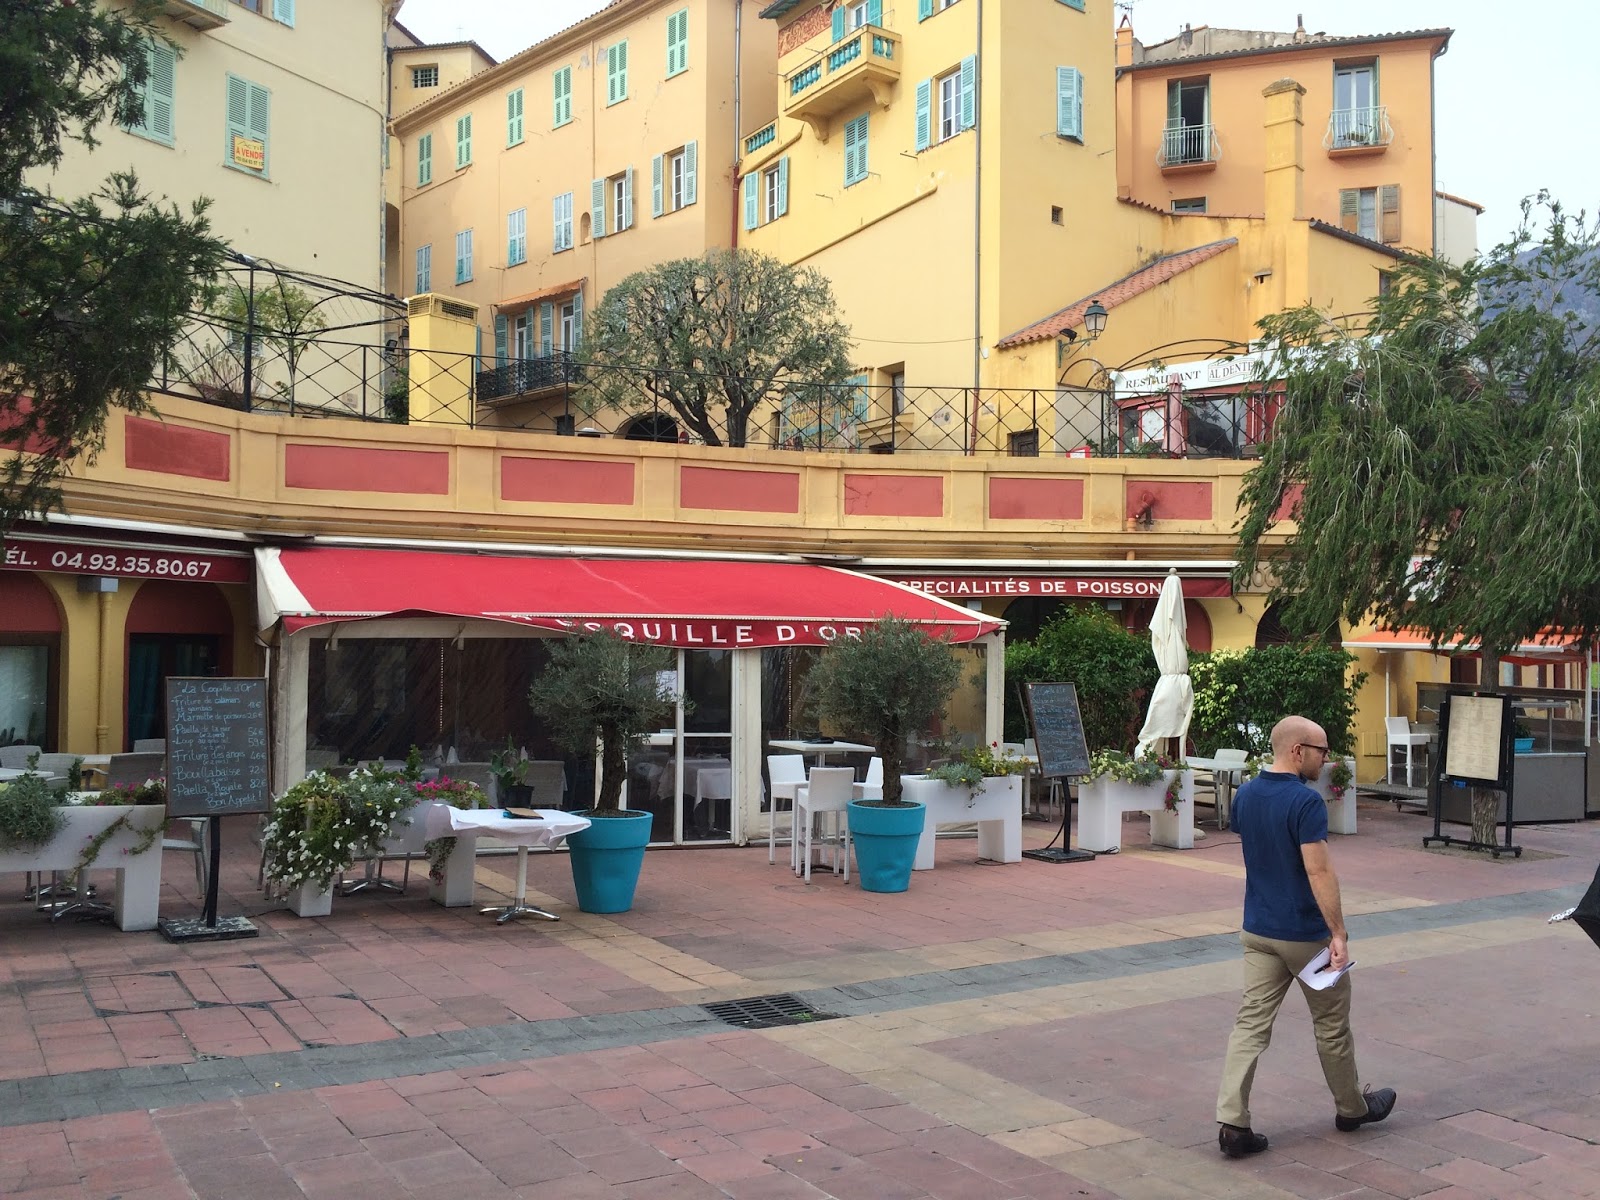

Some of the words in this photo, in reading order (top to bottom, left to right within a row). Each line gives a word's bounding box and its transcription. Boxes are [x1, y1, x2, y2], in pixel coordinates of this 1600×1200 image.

[1126, 370, 1202, 388] RESTAUANT
[1210, 369, 1221, 378] AL
[3, 546, 38, 566] ÉL.
[52, 550, 211, 577] 04.93.35.80.67
[1040, 581, 1067, 594] DE
[1077, 582, 1163, 595] POISSON
[212, 782, 243, 795] Royale
[205, 796, 226, 808] Bon
